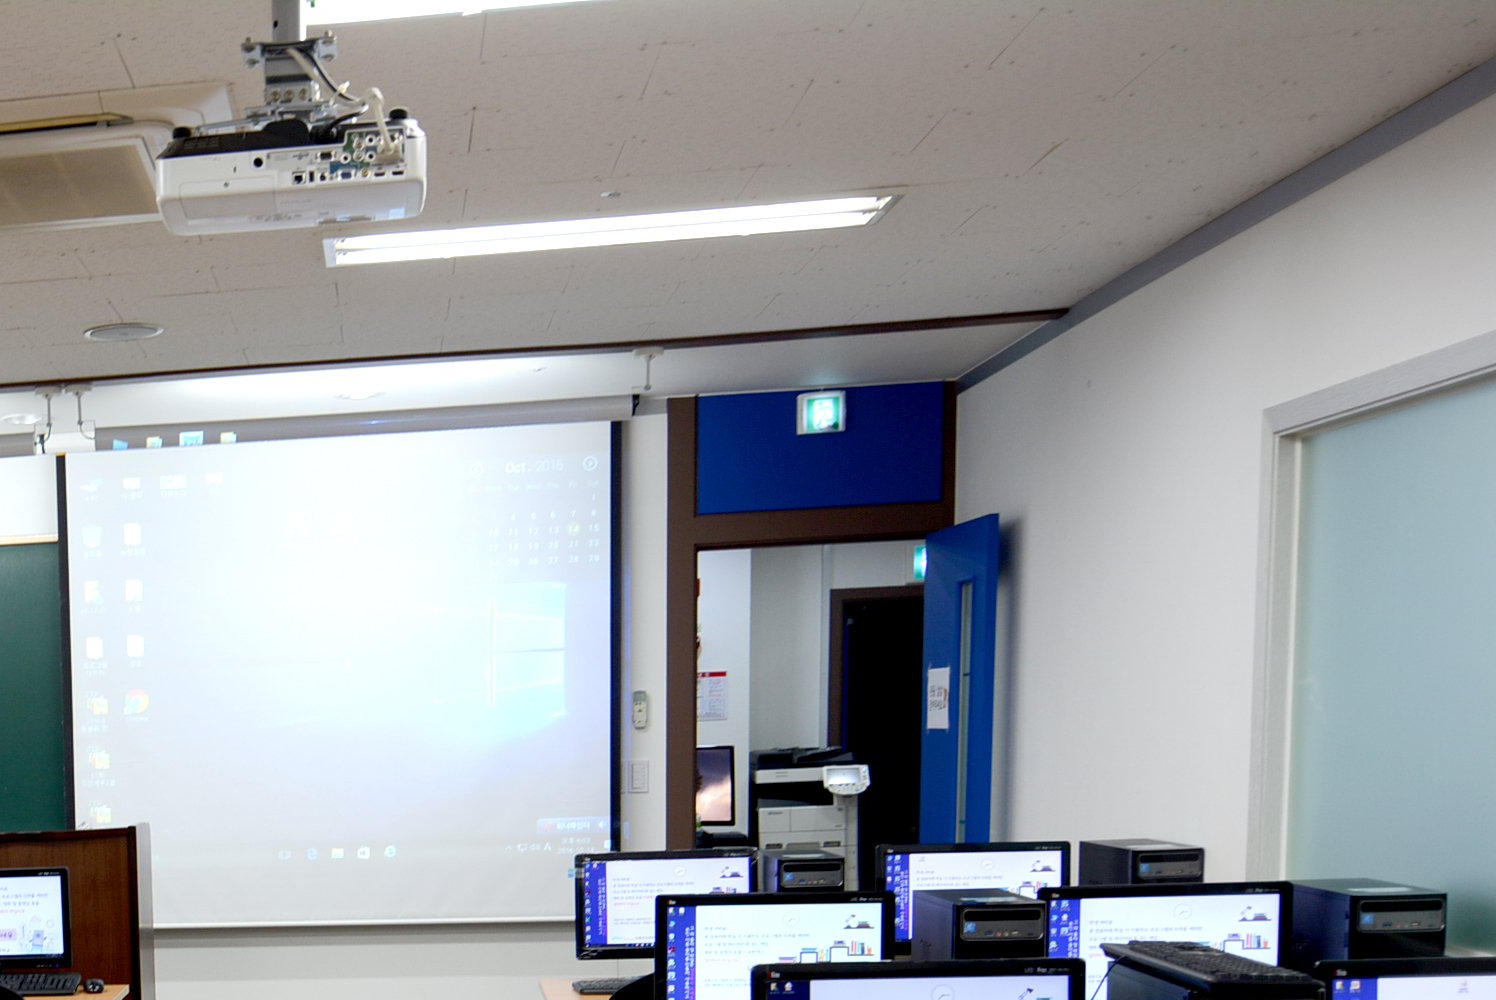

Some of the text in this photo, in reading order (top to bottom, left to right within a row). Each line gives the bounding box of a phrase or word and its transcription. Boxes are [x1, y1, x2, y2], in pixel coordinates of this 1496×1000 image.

[505, 459, 564, 473] Oct. 2016
[488, 524, 600, 537] 10 11 12 13 14 15
